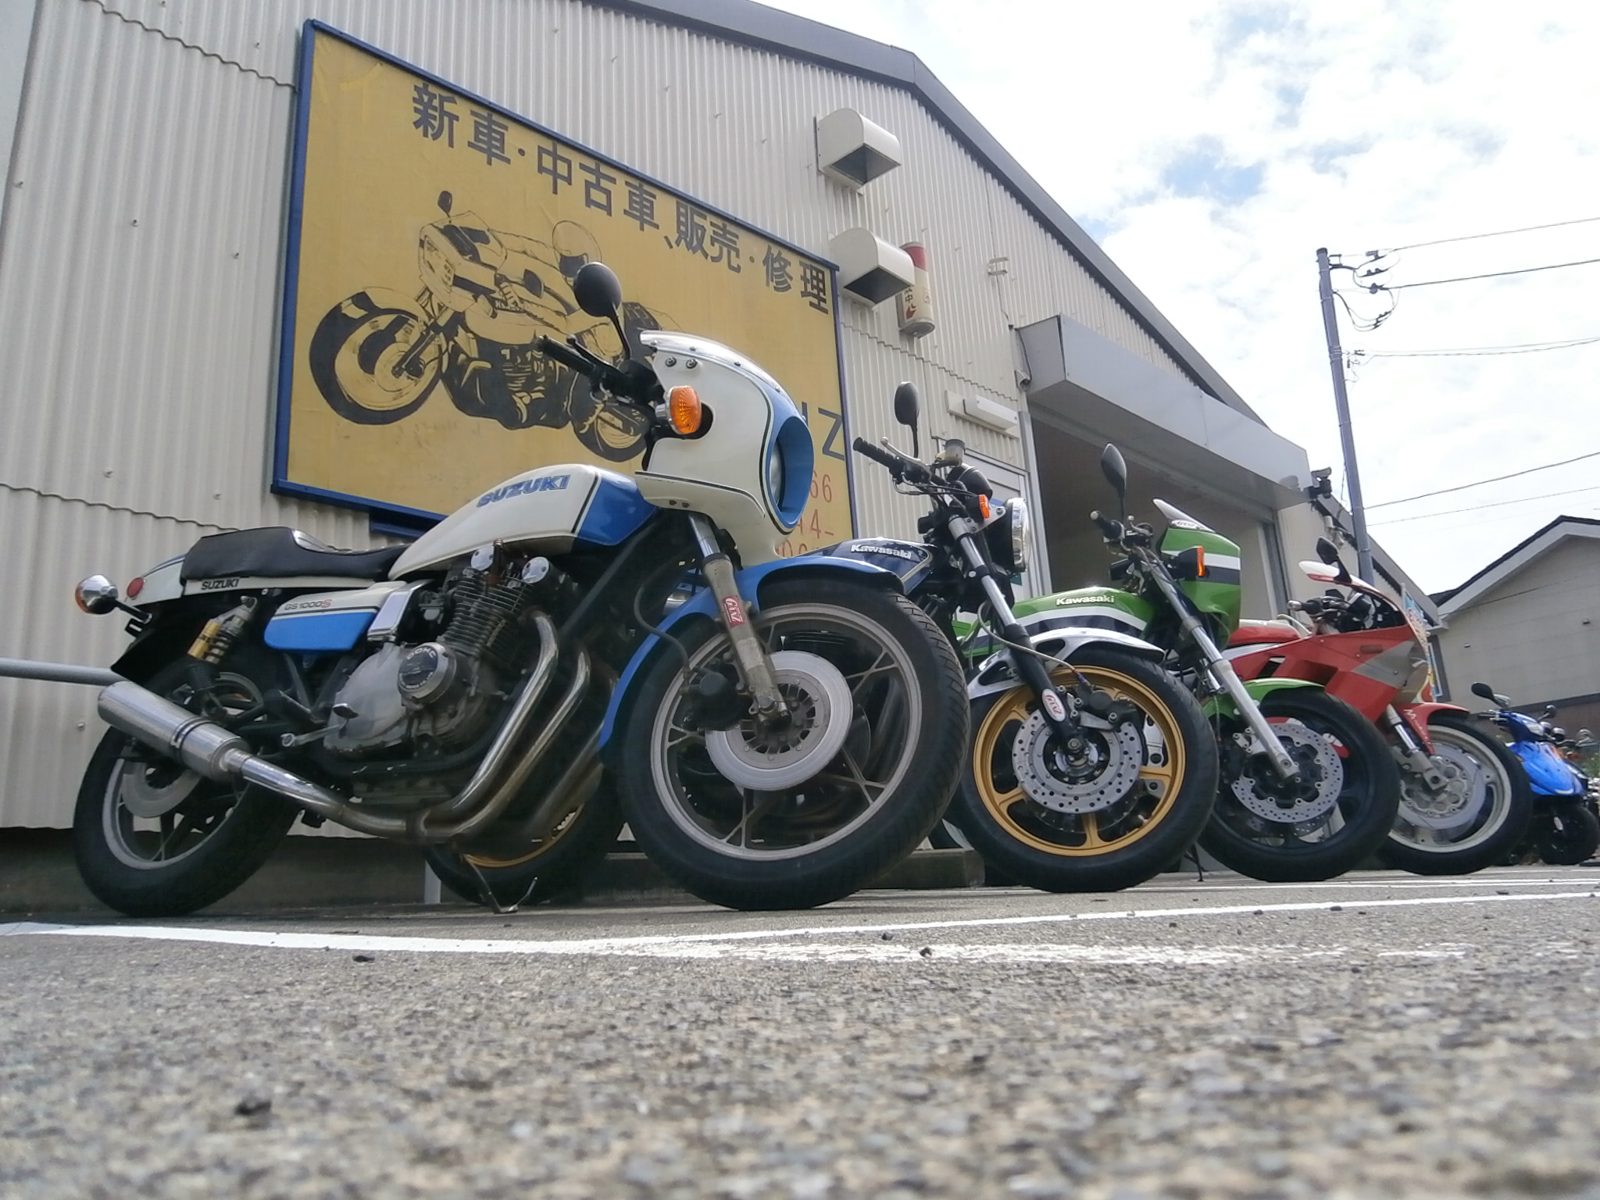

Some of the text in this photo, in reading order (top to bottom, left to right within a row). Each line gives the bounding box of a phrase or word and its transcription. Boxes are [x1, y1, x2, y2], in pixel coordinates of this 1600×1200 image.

[476, 474, 571, 508] SUZUKI
[851, 544, 912, 559] Kawasaki
[201, 578, 240, 591] SUZUKI
[1056, 594, 1115, 606] Kawasaki
